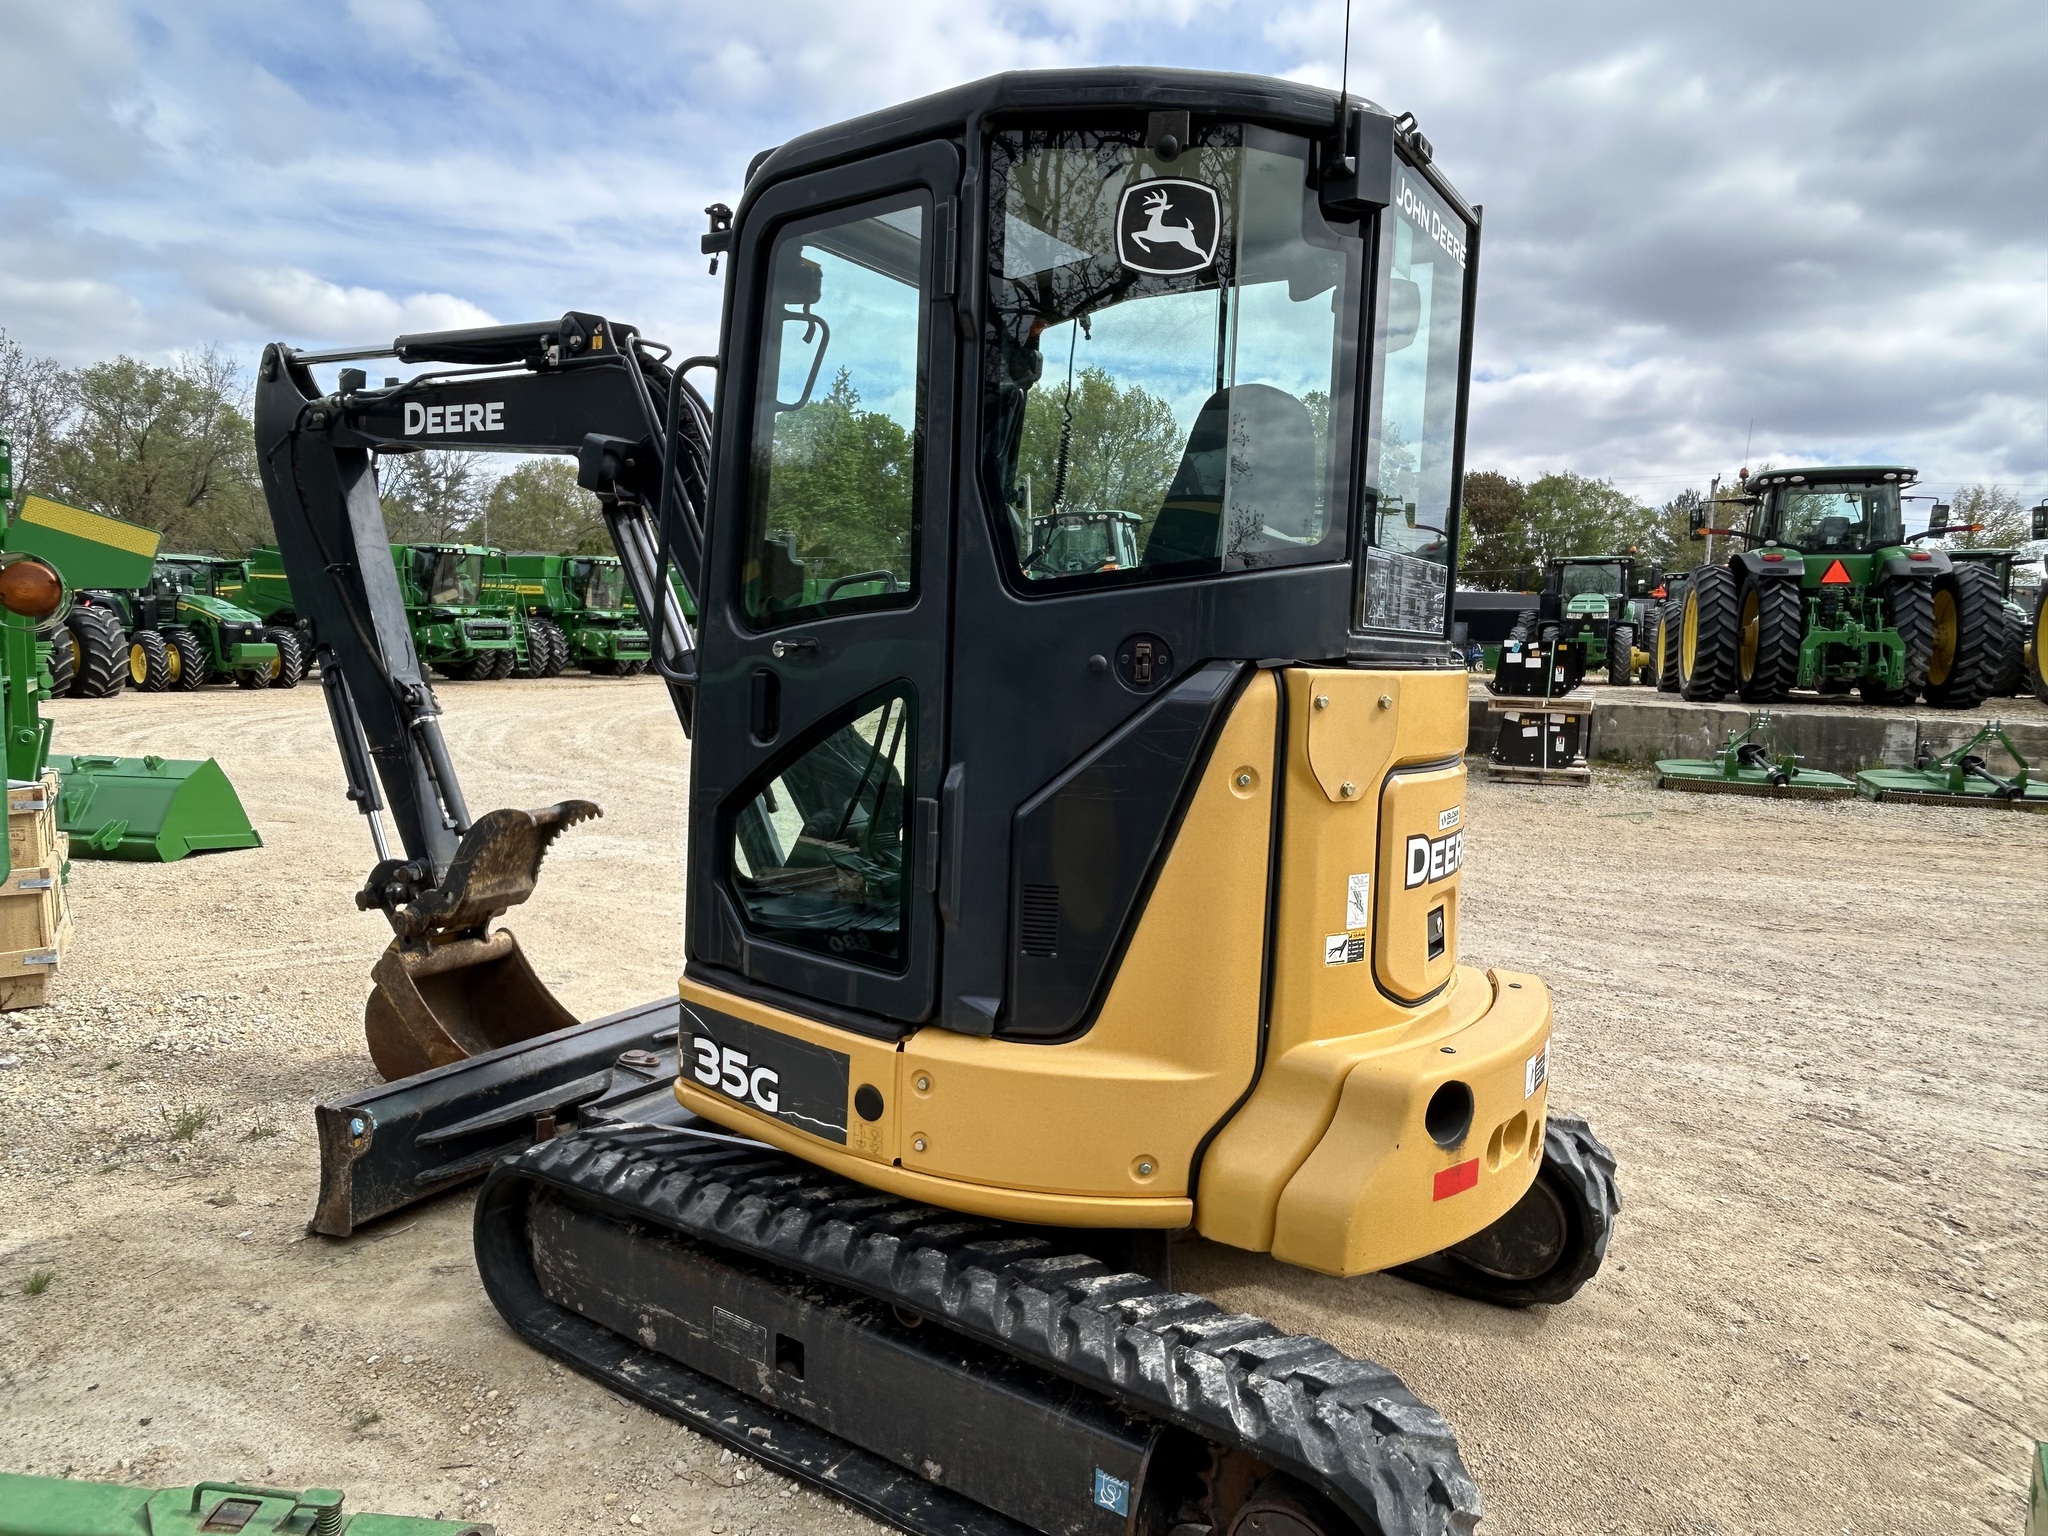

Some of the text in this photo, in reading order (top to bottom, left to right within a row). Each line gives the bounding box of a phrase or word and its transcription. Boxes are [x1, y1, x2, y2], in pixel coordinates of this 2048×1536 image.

[1396, 177, 1467, 269] JOHN DEERE
[404, 401, 505, 436] DEERE
[1405, 828, 1465, 888] DEER
[693, 1036, 779, 1113] 35G
